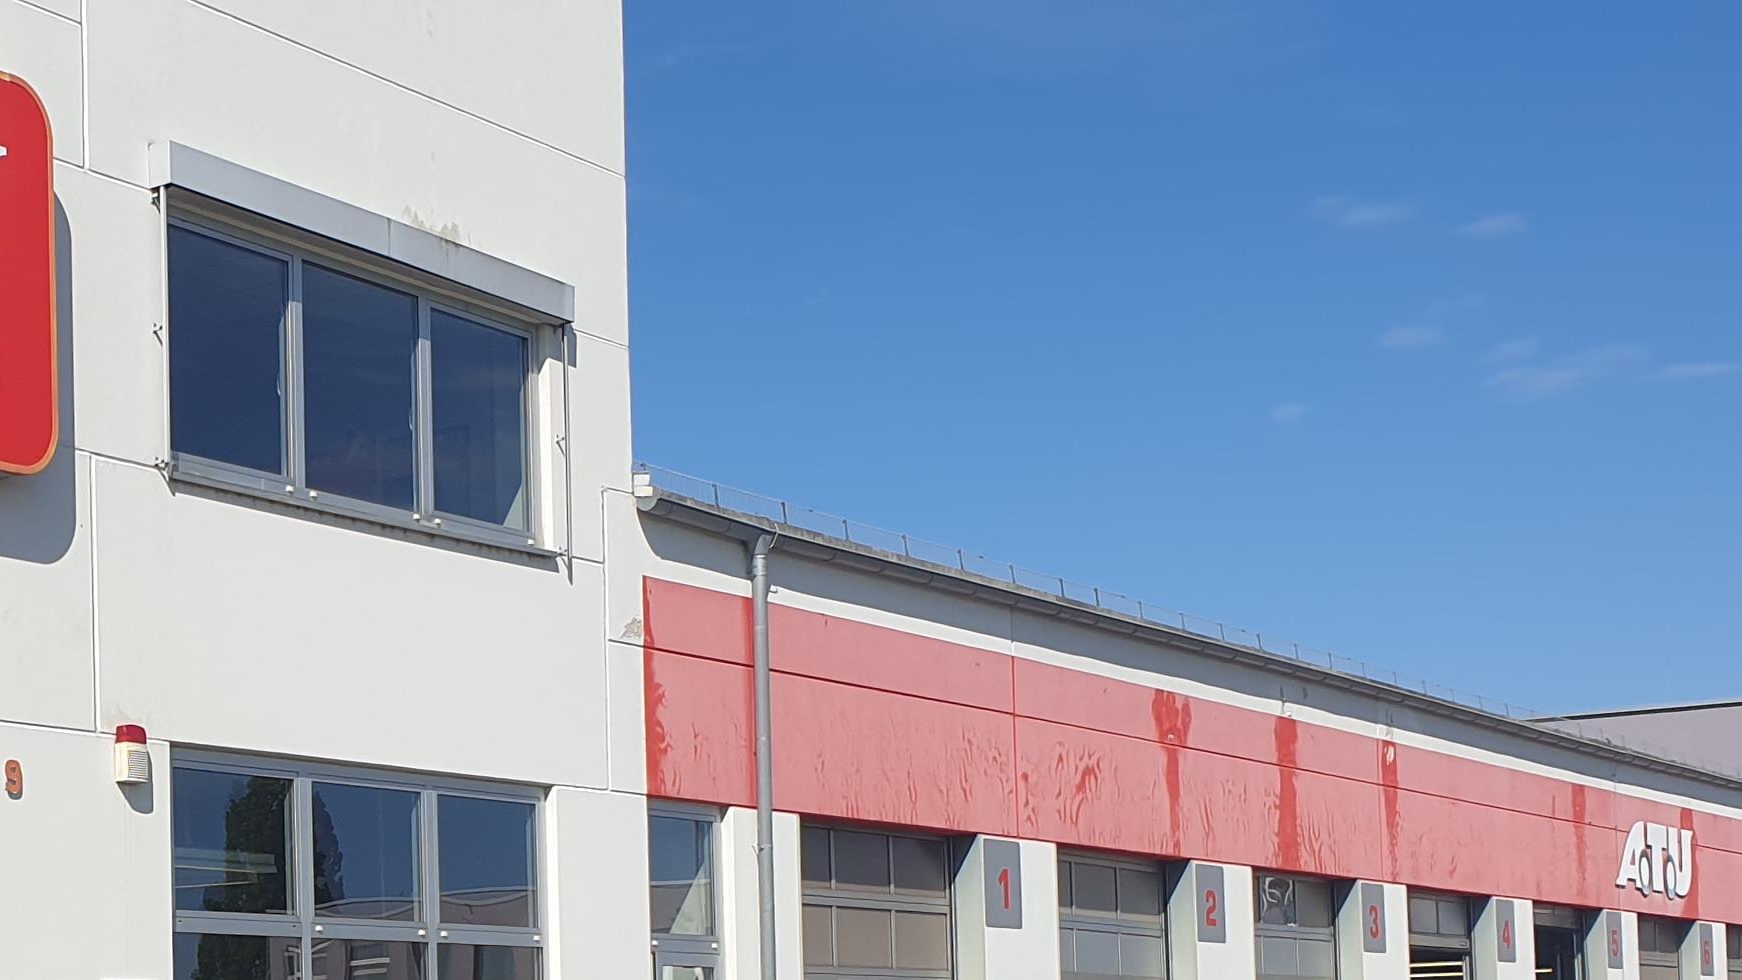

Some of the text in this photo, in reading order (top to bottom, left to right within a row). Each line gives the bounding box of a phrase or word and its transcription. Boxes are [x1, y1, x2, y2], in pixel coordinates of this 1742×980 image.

[4, 759, 25, 801] 9
[1615, 820, 1694, 900] ATU
[997, 868, 1011, 910] 1
[1205, 889, 1218, 927] 2
[1369, 904, 1380, 940] 3
[1502, 919, 1511, 950] 4
[1611, 929, 1619, 958] 5
[1703, 940, 1711, 966] 6
